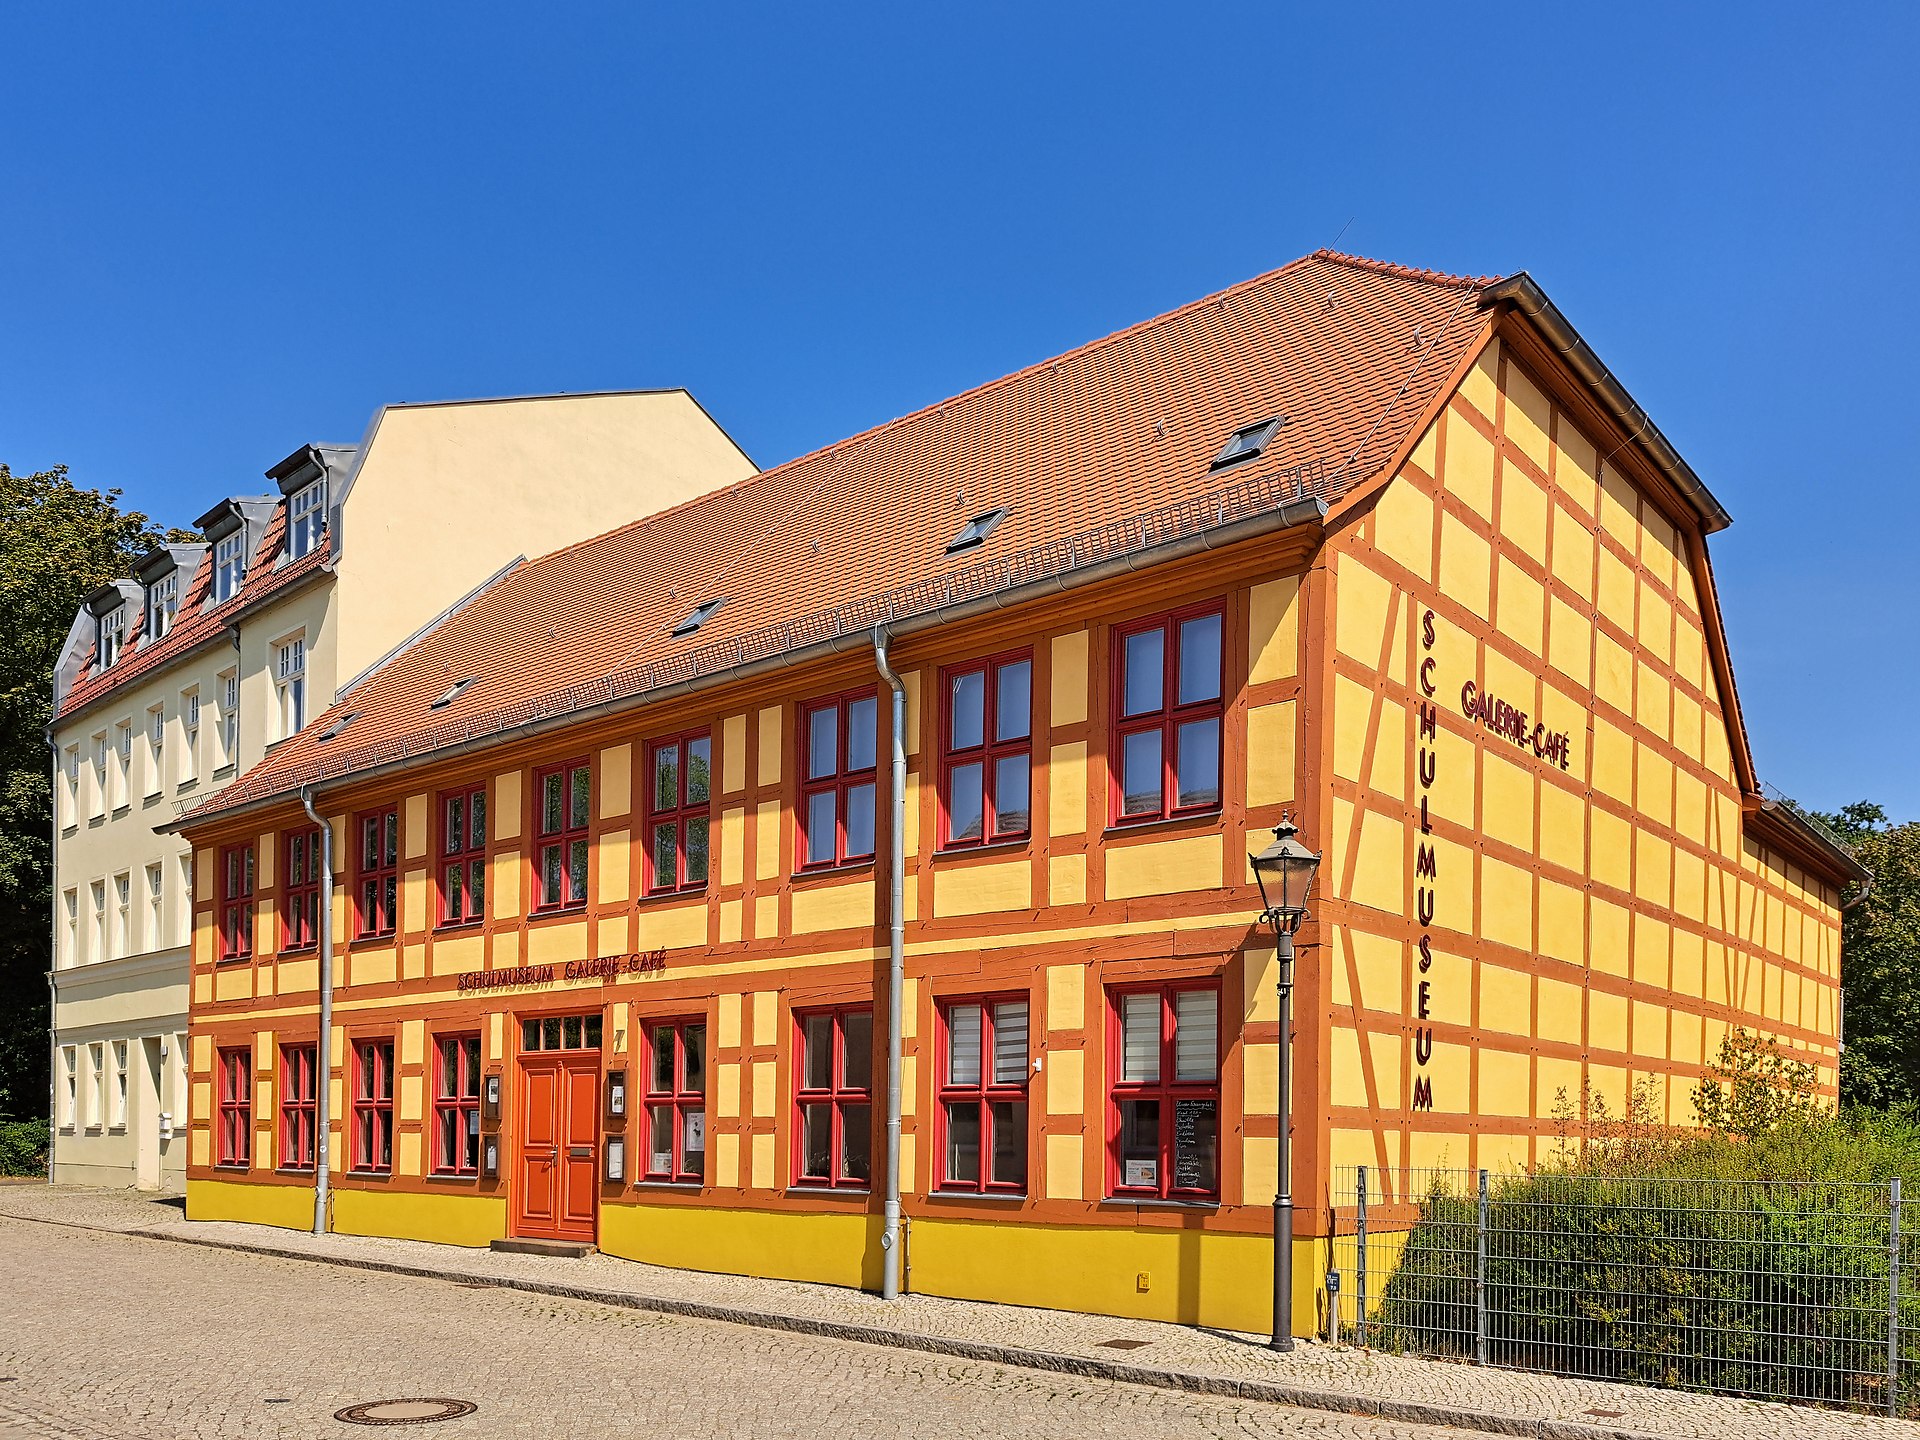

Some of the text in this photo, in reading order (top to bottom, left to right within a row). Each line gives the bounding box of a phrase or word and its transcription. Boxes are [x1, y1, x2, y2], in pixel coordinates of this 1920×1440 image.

[1460, 680, 1570, 769] GALERIE-CAFÉ
[1413, 609, 1437, 1113] SCHULMUSEUM
[457, 965, 555, 991] SCHULMUSEUM
